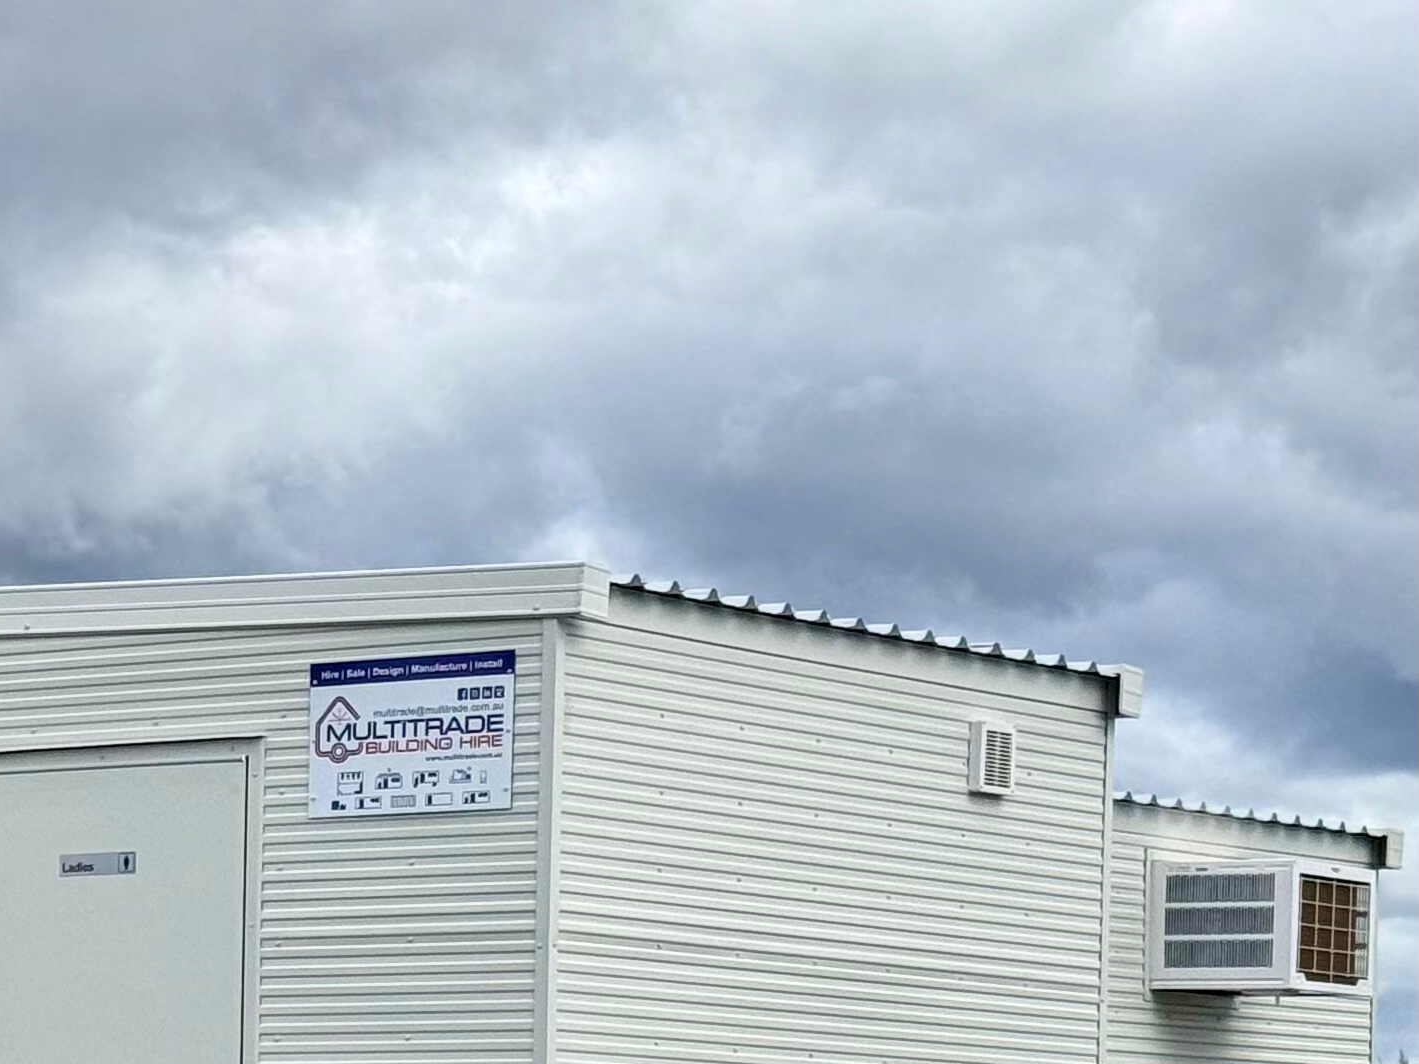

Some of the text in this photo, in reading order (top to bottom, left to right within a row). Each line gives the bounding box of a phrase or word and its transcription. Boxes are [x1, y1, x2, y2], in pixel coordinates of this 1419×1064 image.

[320, 658, 504, 680] Hire Sale Design Manufacture Install
[373, 703, 504, 718] multitrade@multitrade.com.au
[326, 714, 504, 742] MULTITRADE
[365, 734, 504, 755] BUILDING HIRE
[62, 861, 95, 873] Ladies
